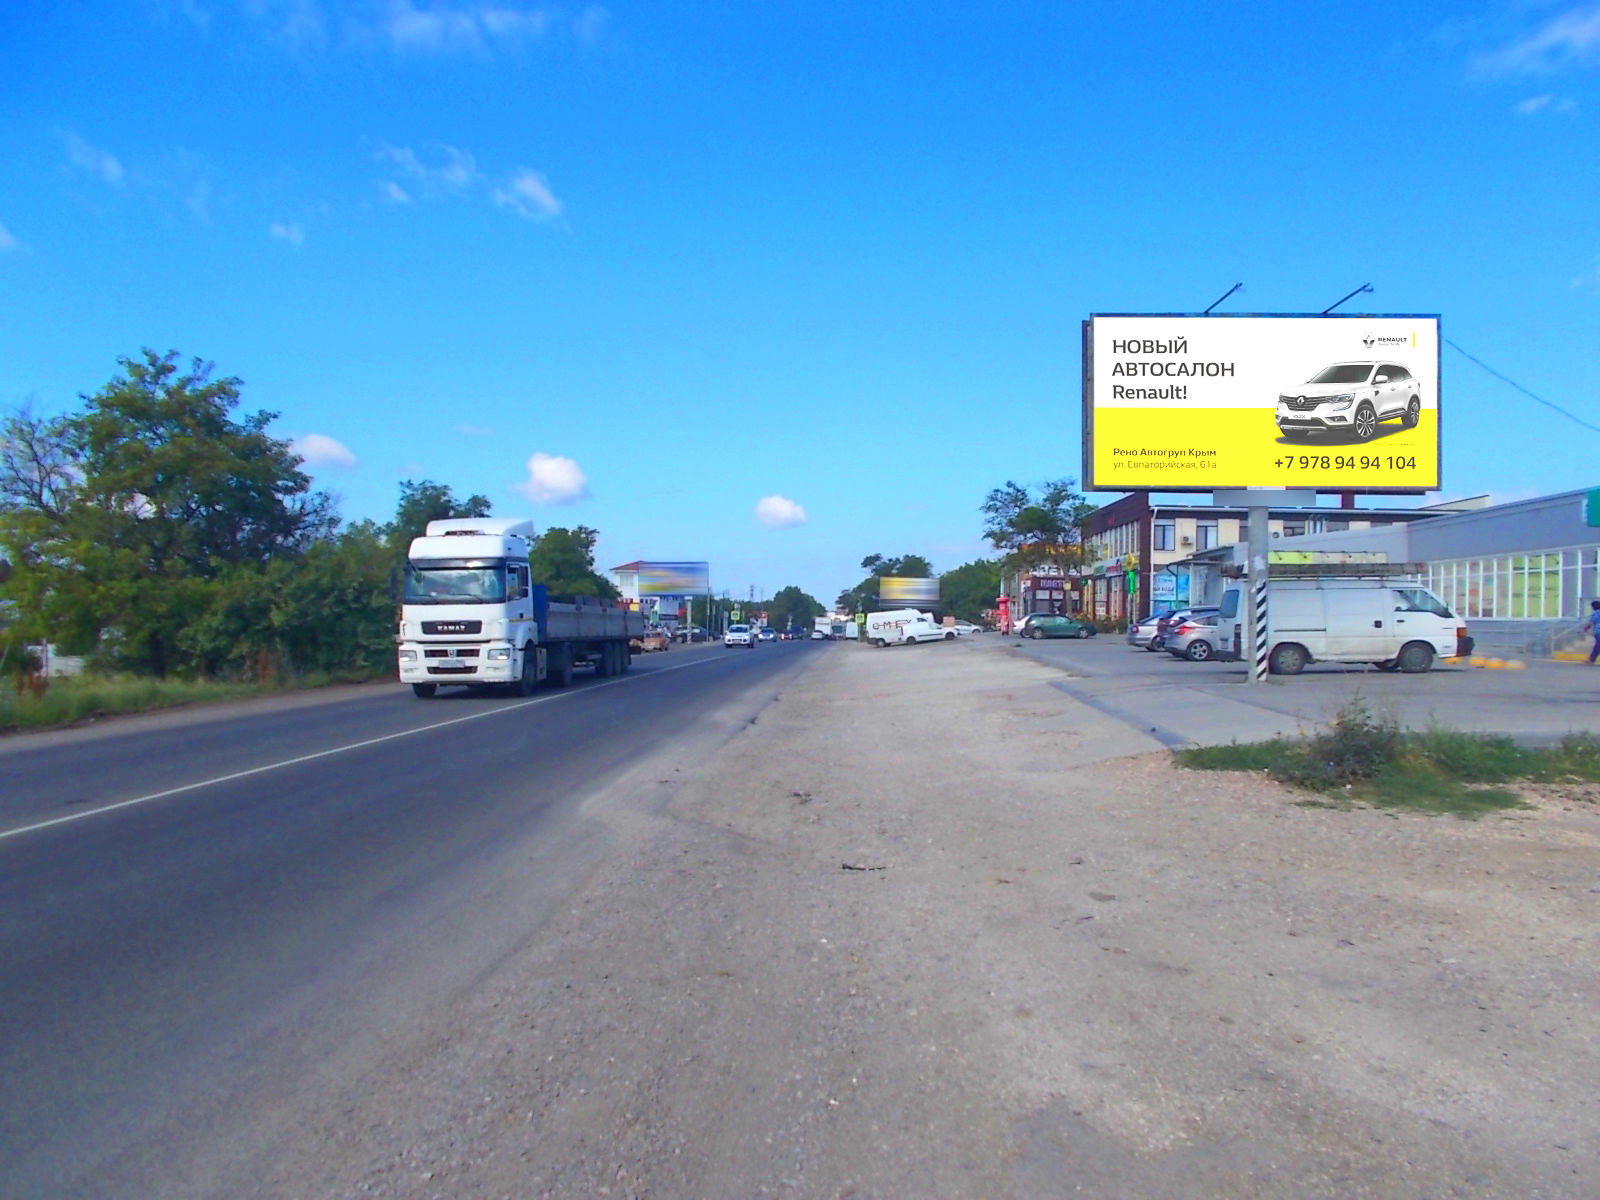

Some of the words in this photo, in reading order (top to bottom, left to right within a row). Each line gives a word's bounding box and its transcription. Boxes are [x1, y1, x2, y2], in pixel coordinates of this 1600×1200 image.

[1112, 335, 1188, 355] НОВЫЙ
[1111, 361, 1235, 377] АВТОСАЛОН
[1112, 384, 1188, 400] Renault!
[1112, 447, 1138, 457] Рено
[1139, 447, 1186, 459] Автогруп
[1188, 447, 1217, 459] Крым
[1112, 462, 1126, 471] ул.
[1127, 460, 1198, 471] Евпаторийская,
[1274, 455, 1294, 469] +7
[1299, 455, 1331, 470] 978
[1334, 455, 1356, 470] 94
[1359, 455, 1381, 470] 94
[1386, 455, 1417, 470] 104
